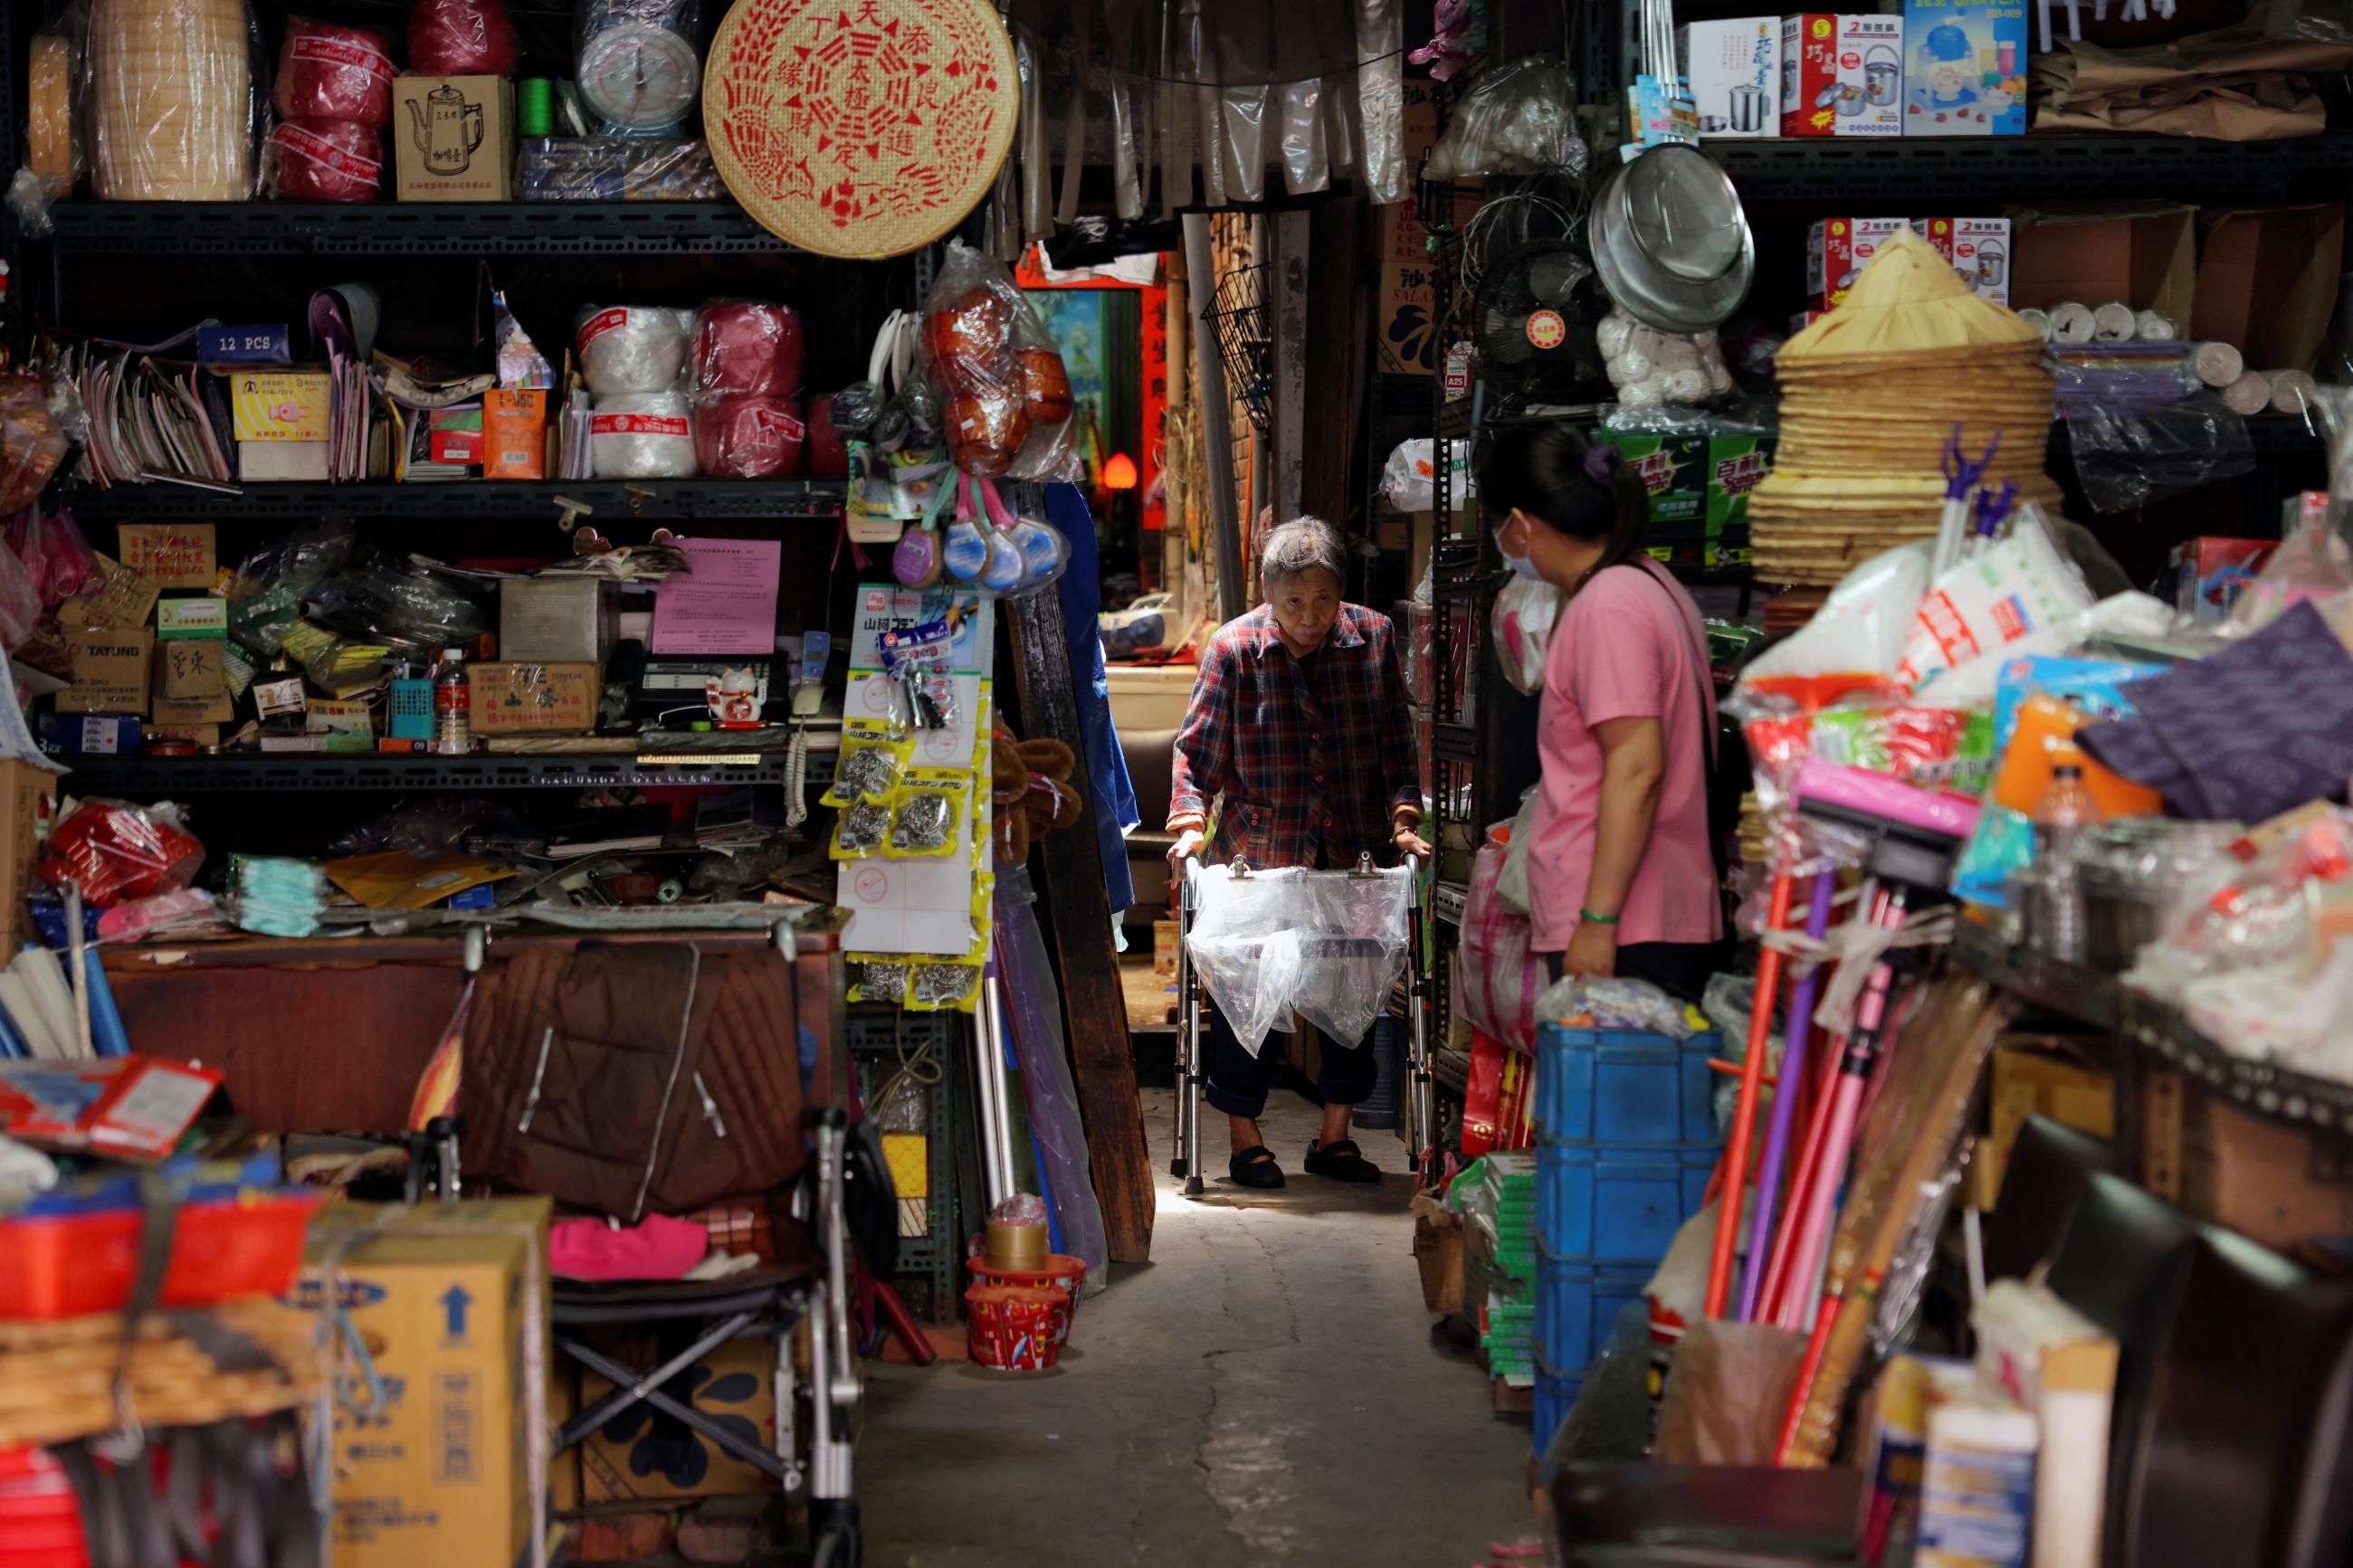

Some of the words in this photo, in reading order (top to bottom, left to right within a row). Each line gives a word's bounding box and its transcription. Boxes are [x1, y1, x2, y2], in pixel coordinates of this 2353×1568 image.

[856, 1, 881, 26] 天
[806, 16, 832, 42] 丁
[900, 25, 933, 55] 添
[844, 59, 870, 109] 太極
[917, 80, 939, 109] 良
[788, 112, 814, 137] 財
[886, 128, 912, 156] 進
[834, 142, 859, 172] 定
[219, 337, 236, 351] 12
[245, 336, 271, 350] PCS
[88, 646, 139, 657] TATUNG
